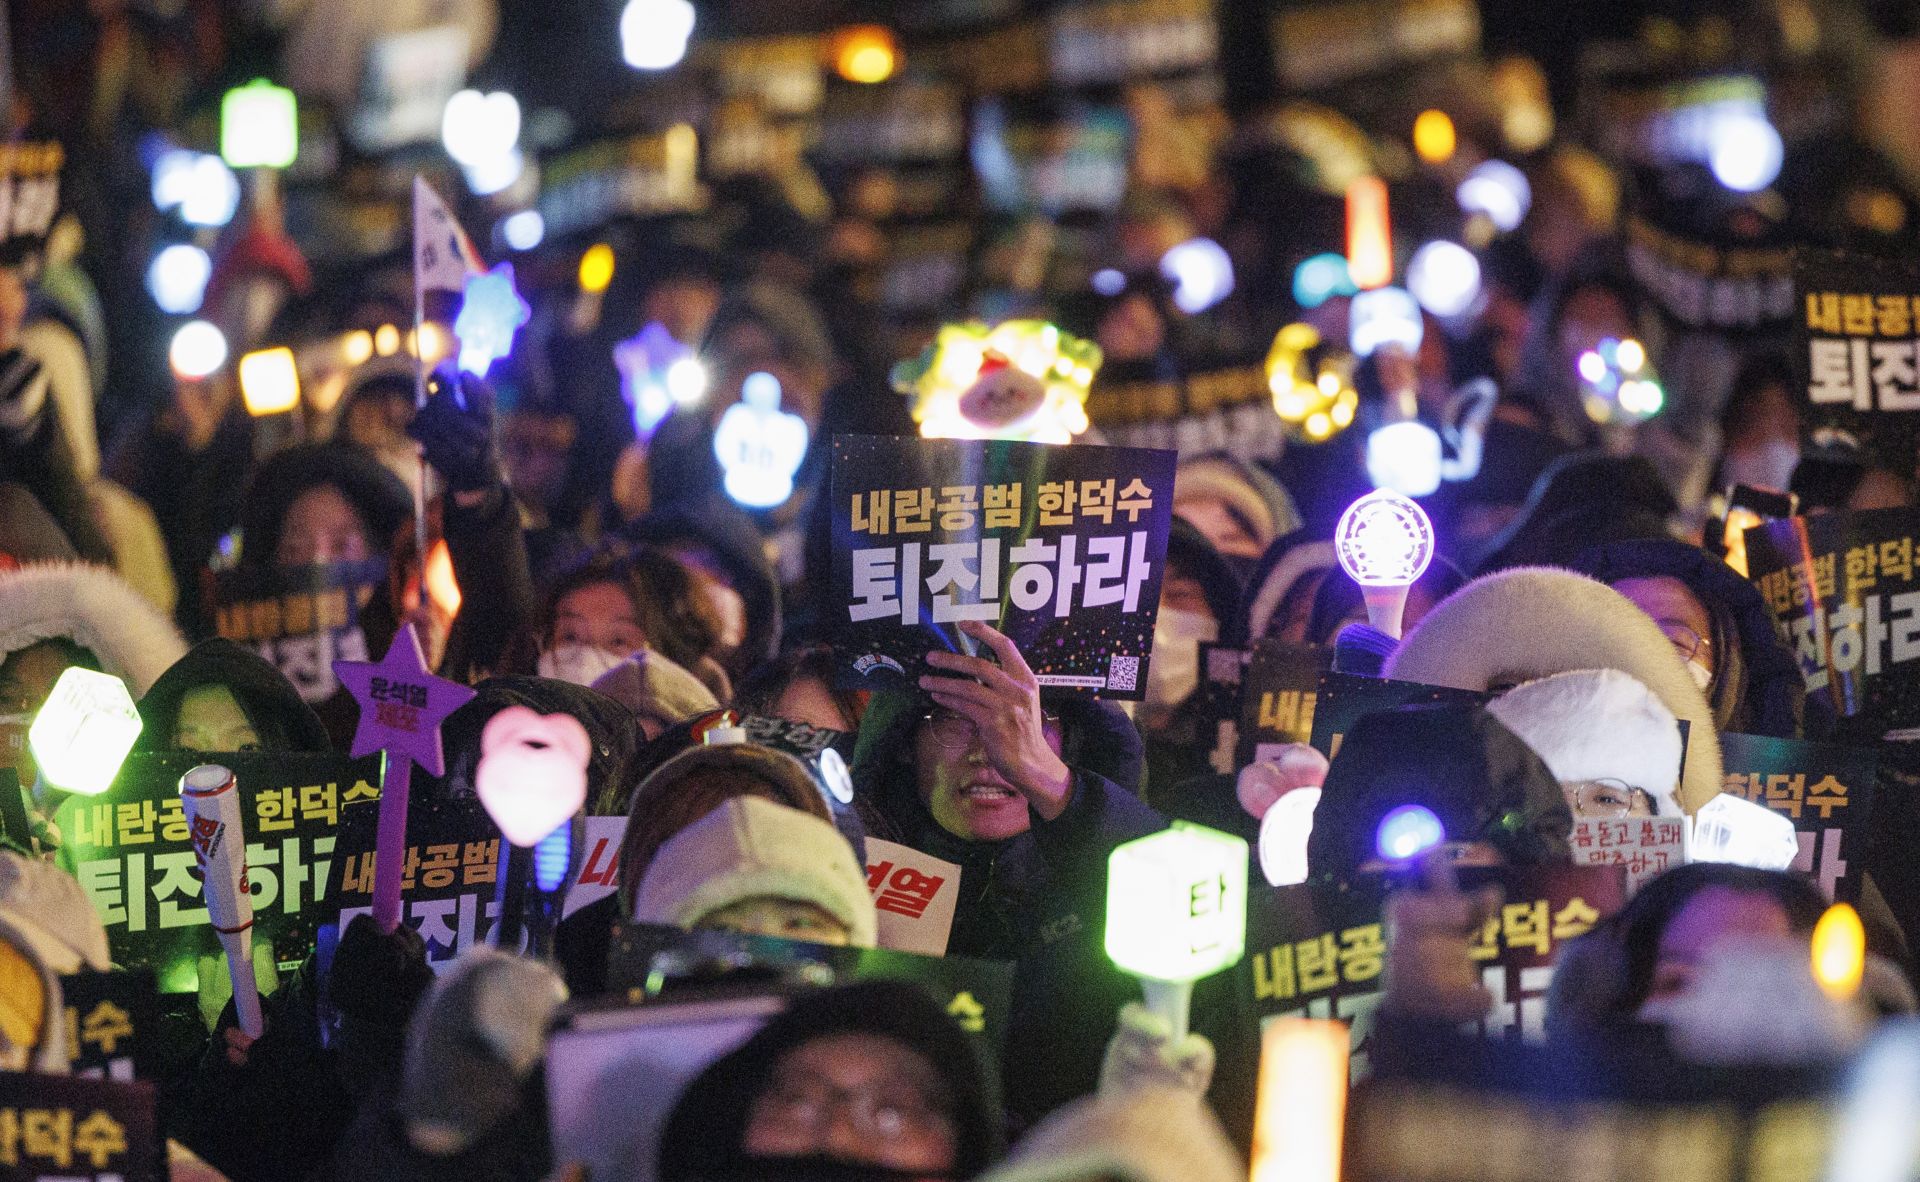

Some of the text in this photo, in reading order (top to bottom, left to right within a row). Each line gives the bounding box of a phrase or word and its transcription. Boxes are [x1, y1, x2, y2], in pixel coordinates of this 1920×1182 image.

[1806, 291, 1920, 336] 내란공
[850, 477, 1154, 535] 내란공범 한덕수
[848, 531, 1151, 625] 퇴진하라
[1845, 537, 1920, 590] 한덕
[74, 798, 192, 847] 내란공
[1252, 923, 1387, 1000] 내란공
